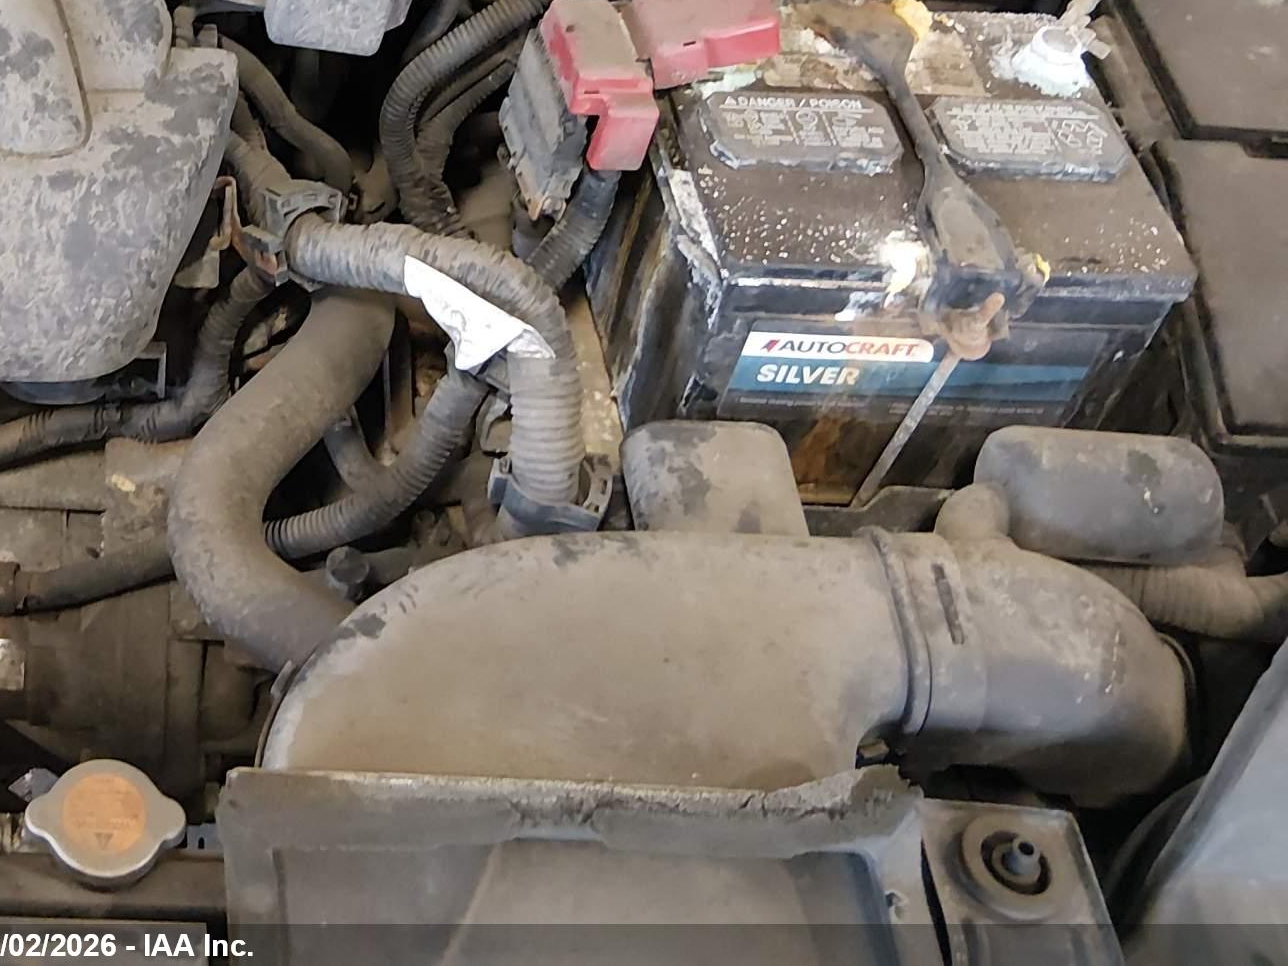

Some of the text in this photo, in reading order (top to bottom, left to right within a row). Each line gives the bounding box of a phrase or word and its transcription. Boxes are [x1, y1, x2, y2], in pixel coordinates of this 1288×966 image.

[738, 96, 863, 109] DANGER / POISON
[779, 338, 921, 357] AUTOCRAFT
[756, 363, 861, 386] SILVER
